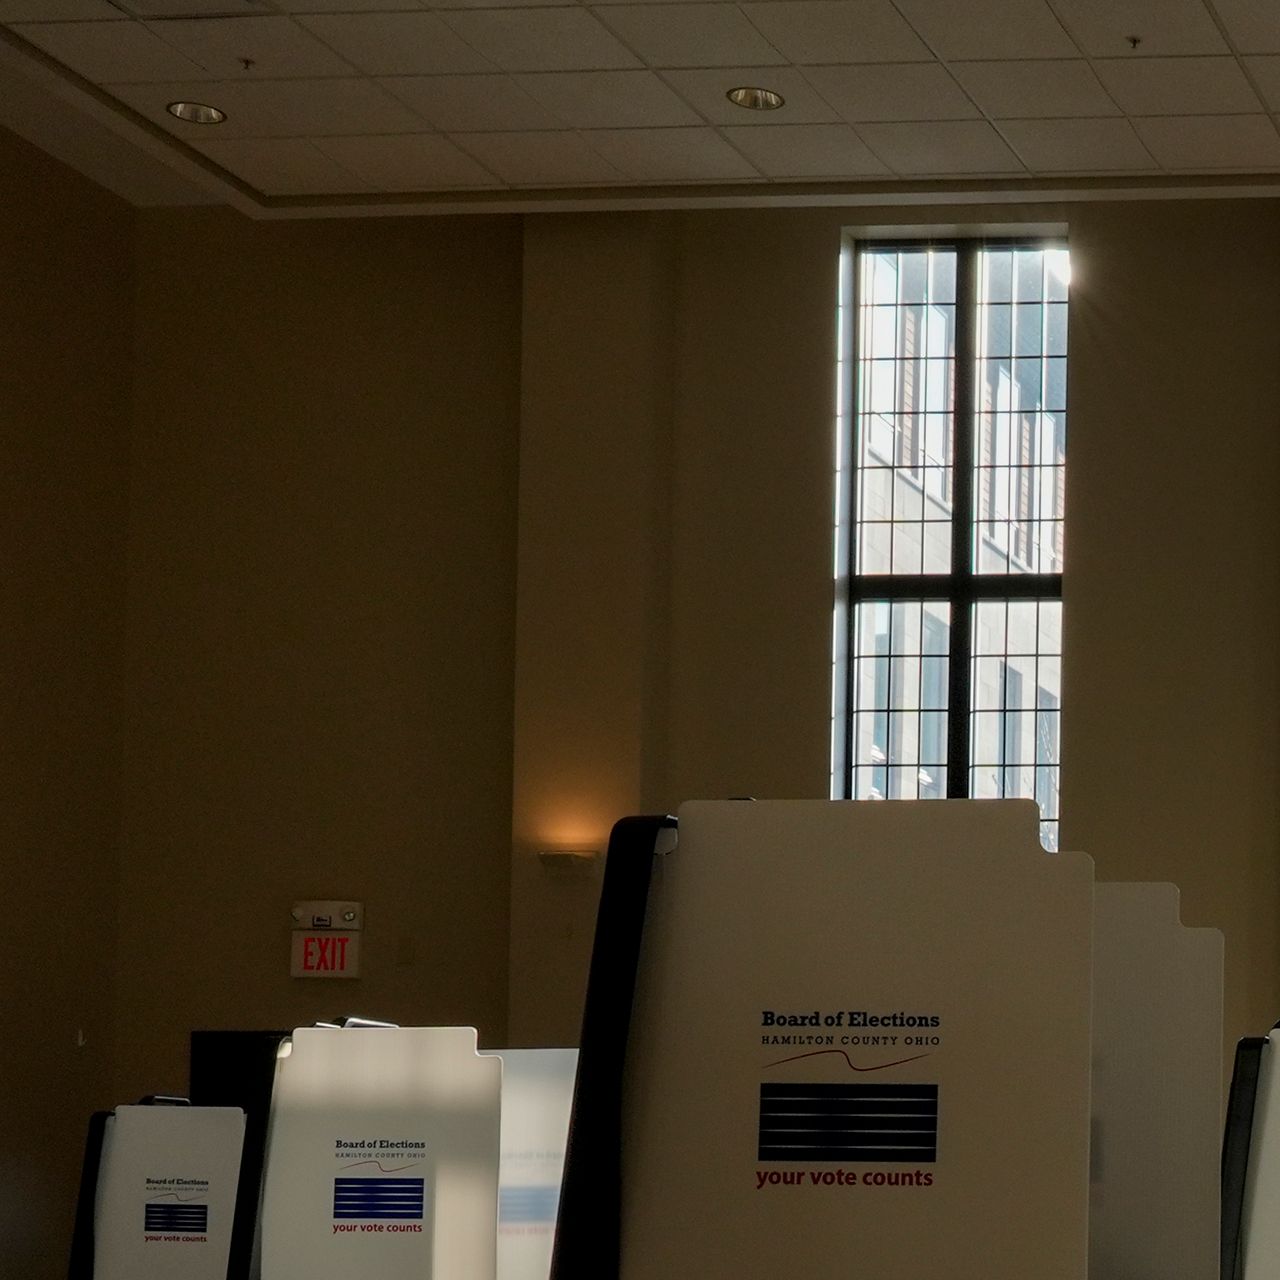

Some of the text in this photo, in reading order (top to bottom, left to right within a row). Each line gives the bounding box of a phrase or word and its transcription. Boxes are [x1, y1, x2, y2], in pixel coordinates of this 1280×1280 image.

[304, 937, 349, 971] EXIT
[761, 1011, 940, 1027] Board of Elections
[761, 1036, 940, 1046] HAMILTON COUNTY OHIO
[335, 1140, 426, 1149] Board of Elections
[756, 1169, 933, 1190] your vote counts
[332, 1223, 423, 1234] your vote counts
[144, 1235, 162, 1243] your
